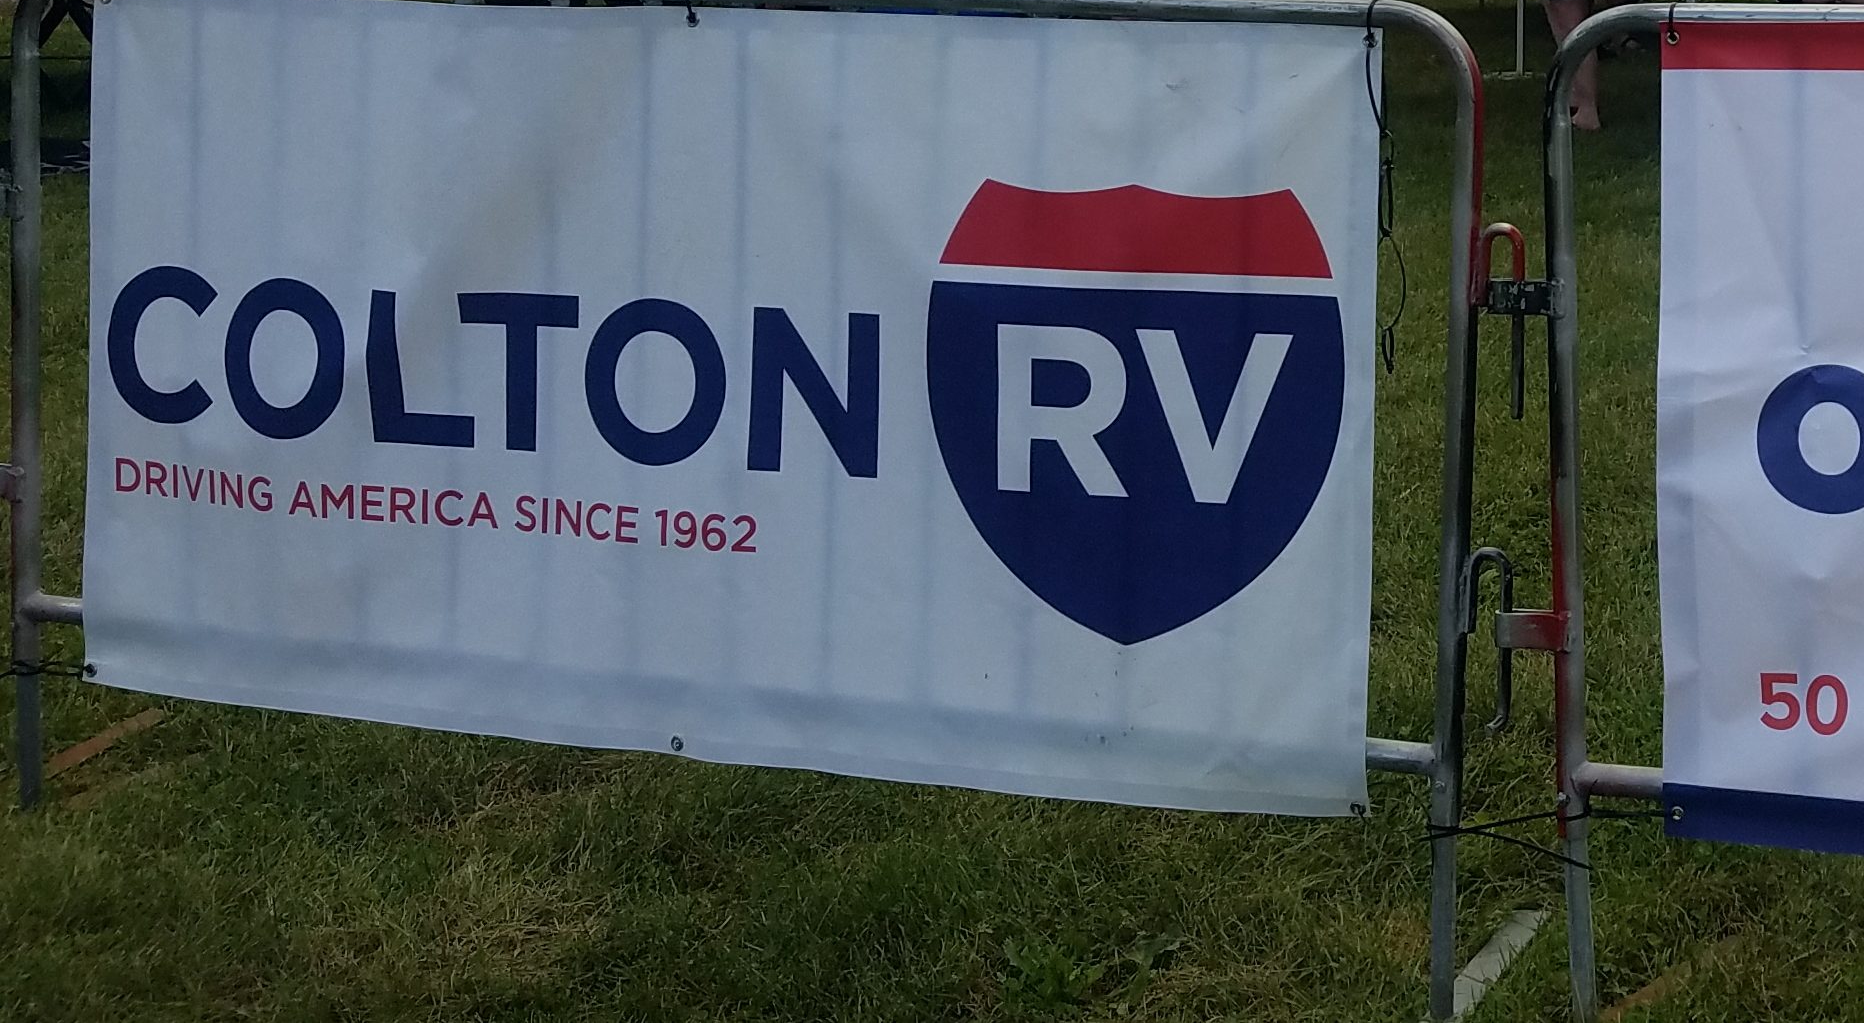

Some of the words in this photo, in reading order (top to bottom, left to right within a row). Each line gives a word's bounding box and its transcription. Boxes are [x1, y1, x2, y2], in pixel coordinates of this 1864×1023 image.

[107, 265, 881, 478] COLTON
[997, 323, 1294, 505] RV
[114, 457, 273, 512] DRIVING
[288, 480, 498, 529] AMERICA
[514, 495, 639, 545] SINCE
[655, 508, 758, 553] 1962
[1759, 671, 1849, 736] 50
